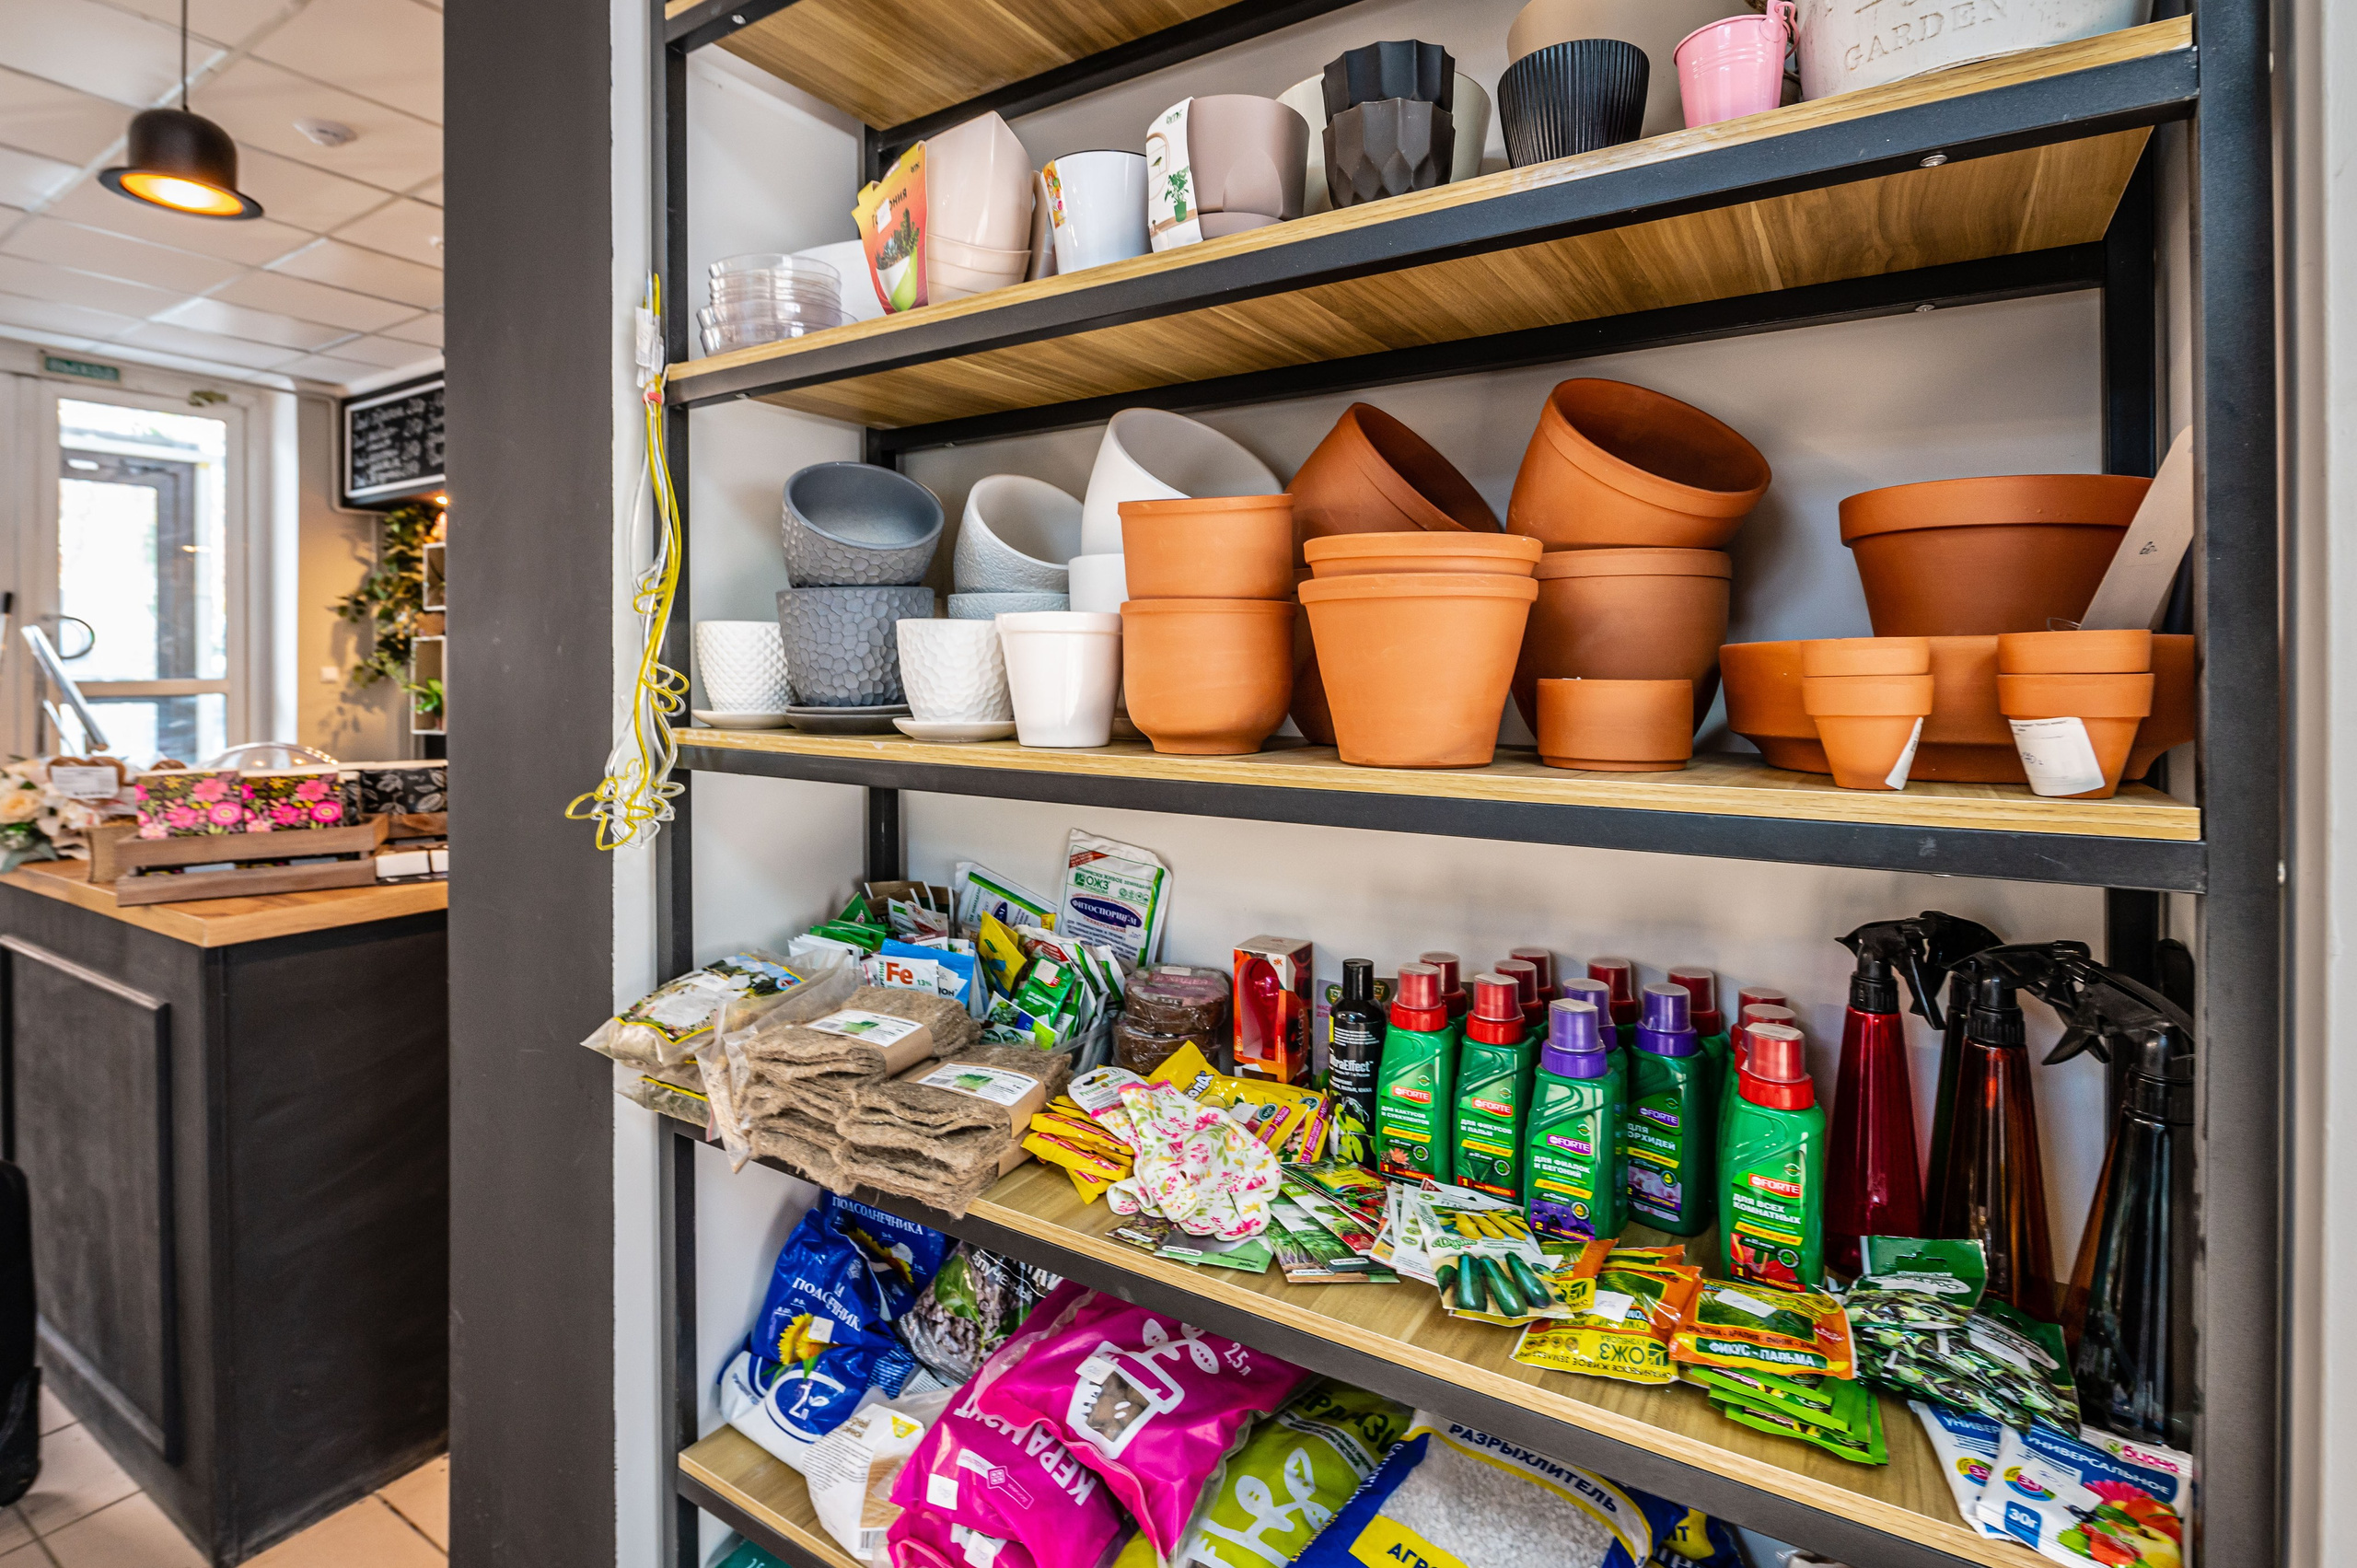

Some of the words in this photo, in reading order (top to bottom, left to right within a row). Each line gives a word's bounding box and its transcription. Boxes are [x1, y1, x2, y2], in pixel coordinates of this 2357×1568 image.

[1844, 1, 2007, 71] GARDEN
[1086, 876, 1109, 890] ОЖЗ
[886, 961, 913, 985] Fe
[917, 979, 932, 987] 13%
[1402, 1089, 1430, 1101] FORTE
[1482, 1101, 1512, 1114] FORTE
[1647, 1109, 1678, 1124] FORTE
[1628, 1123, 1649, 1133] ДЛЯ
[1560, 1138, 1590, 1152] FORTE
[1628, 1131, 1676, 1151] ОРХИДЕЙ
[1534, 1156, 1552, 1165] ДЛЯ
[1553, 1159, 1591, 1174] ФИАЛОК
[1542, 1163, 1582, 1179] БЕГОНИЙ
[1762, 1179, 1800, 1194] FORTE
[1733, 1193, 1755, 1205] ДЛЯ
[1757, 1200, 1785, 1214] ВСЕХ
[1733, 1201, 1802, 1225] КОМНАТНЫХ
[832, 1196, 923, 1236] ПОДСОЛНЕЧНИКА
[1534, 1222, 1544, 1231] 2
[1736, 1267, 1745, 1276] 1
[1224, 1342, 1249, 1369] 2,5
[1599, 1342, 1645, 1365] ОЖЗ
[1708, 1342, 1750, 1356] ФИКУС
[1760, 1349, 1816, 1366] ПАЛЬМА
[1448, 1423, 1618, 1514] РАЗРЫХЛИТЕЛЬ
[2026, 1436, 2171, 1495] УНИВЕРСАЛЬНОЕ
[2009, 1507, 2038, 1527] 30г
[1387, 1541, 1440, 1568] АГР
